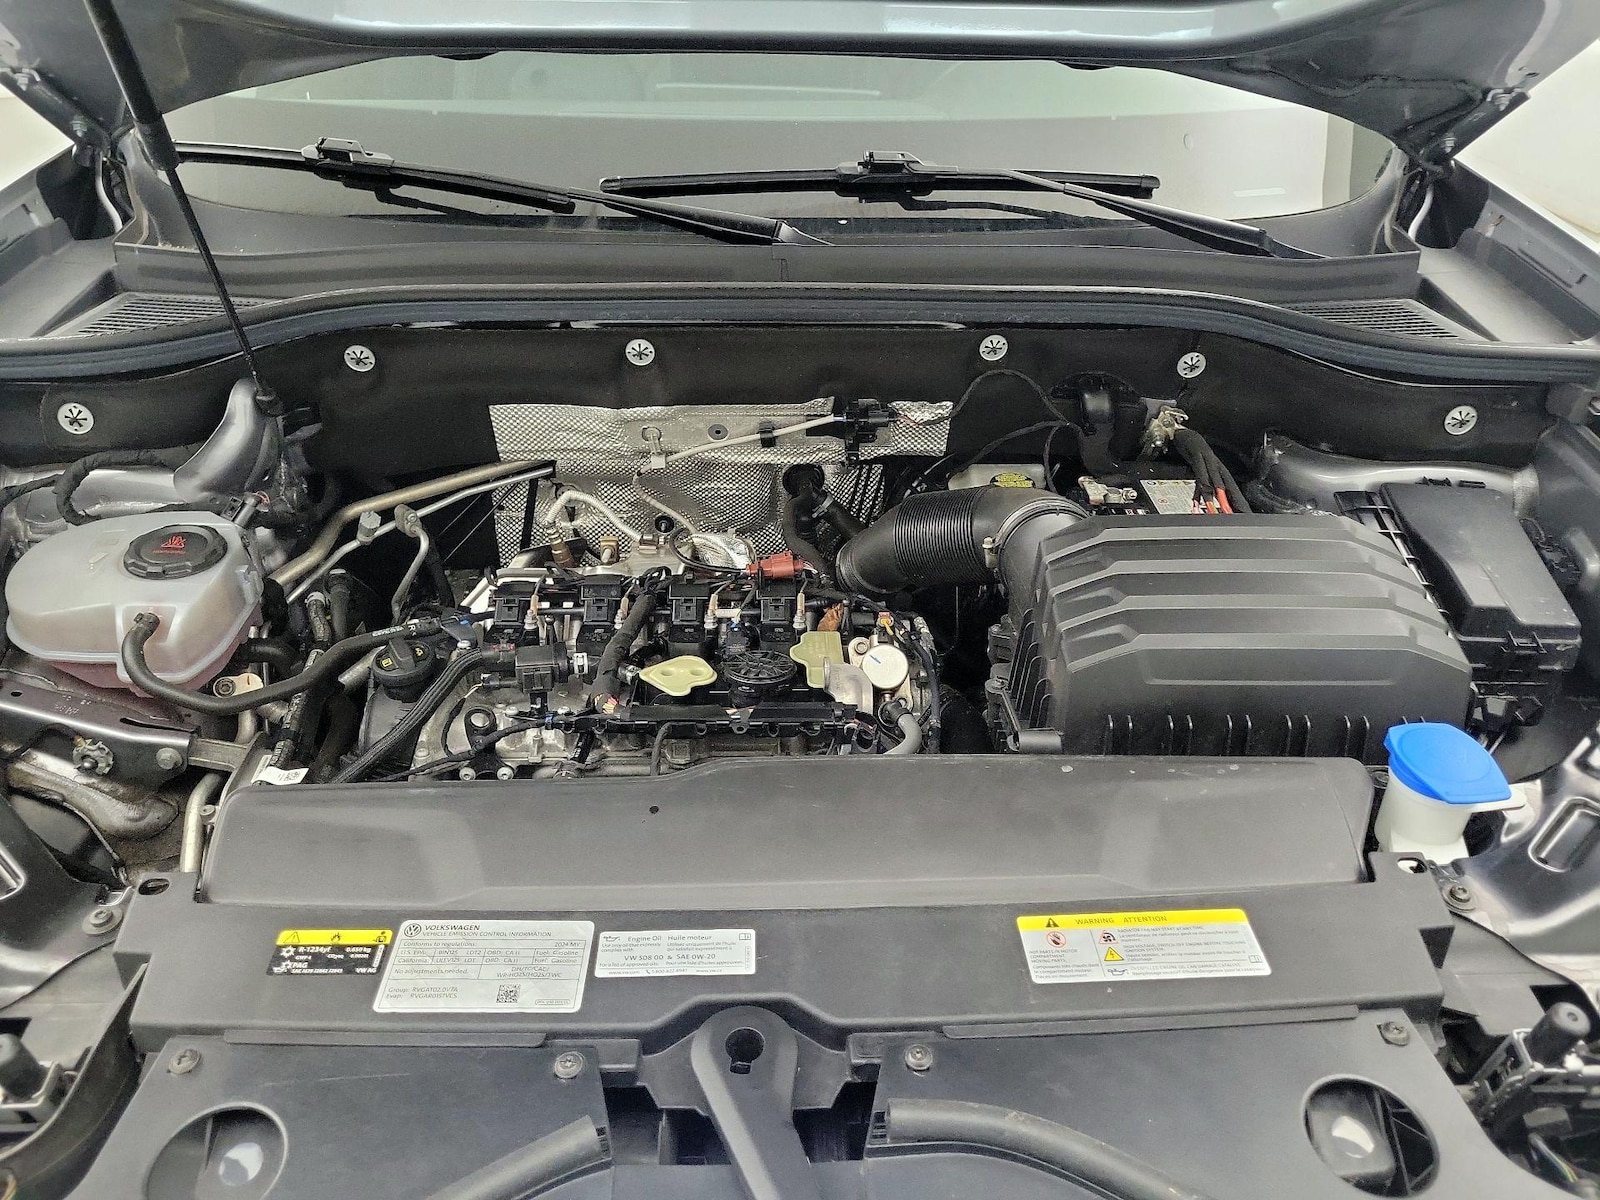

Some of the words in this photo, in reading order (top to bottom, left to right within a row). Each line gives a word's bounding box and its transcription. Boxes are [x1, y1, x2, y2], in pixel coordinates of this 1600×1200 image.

[1075, 917, 1115, 925] WARNING
[1123, 915, 1168, 923] ATTENTION
[627, 935, 651, 943] Engine
